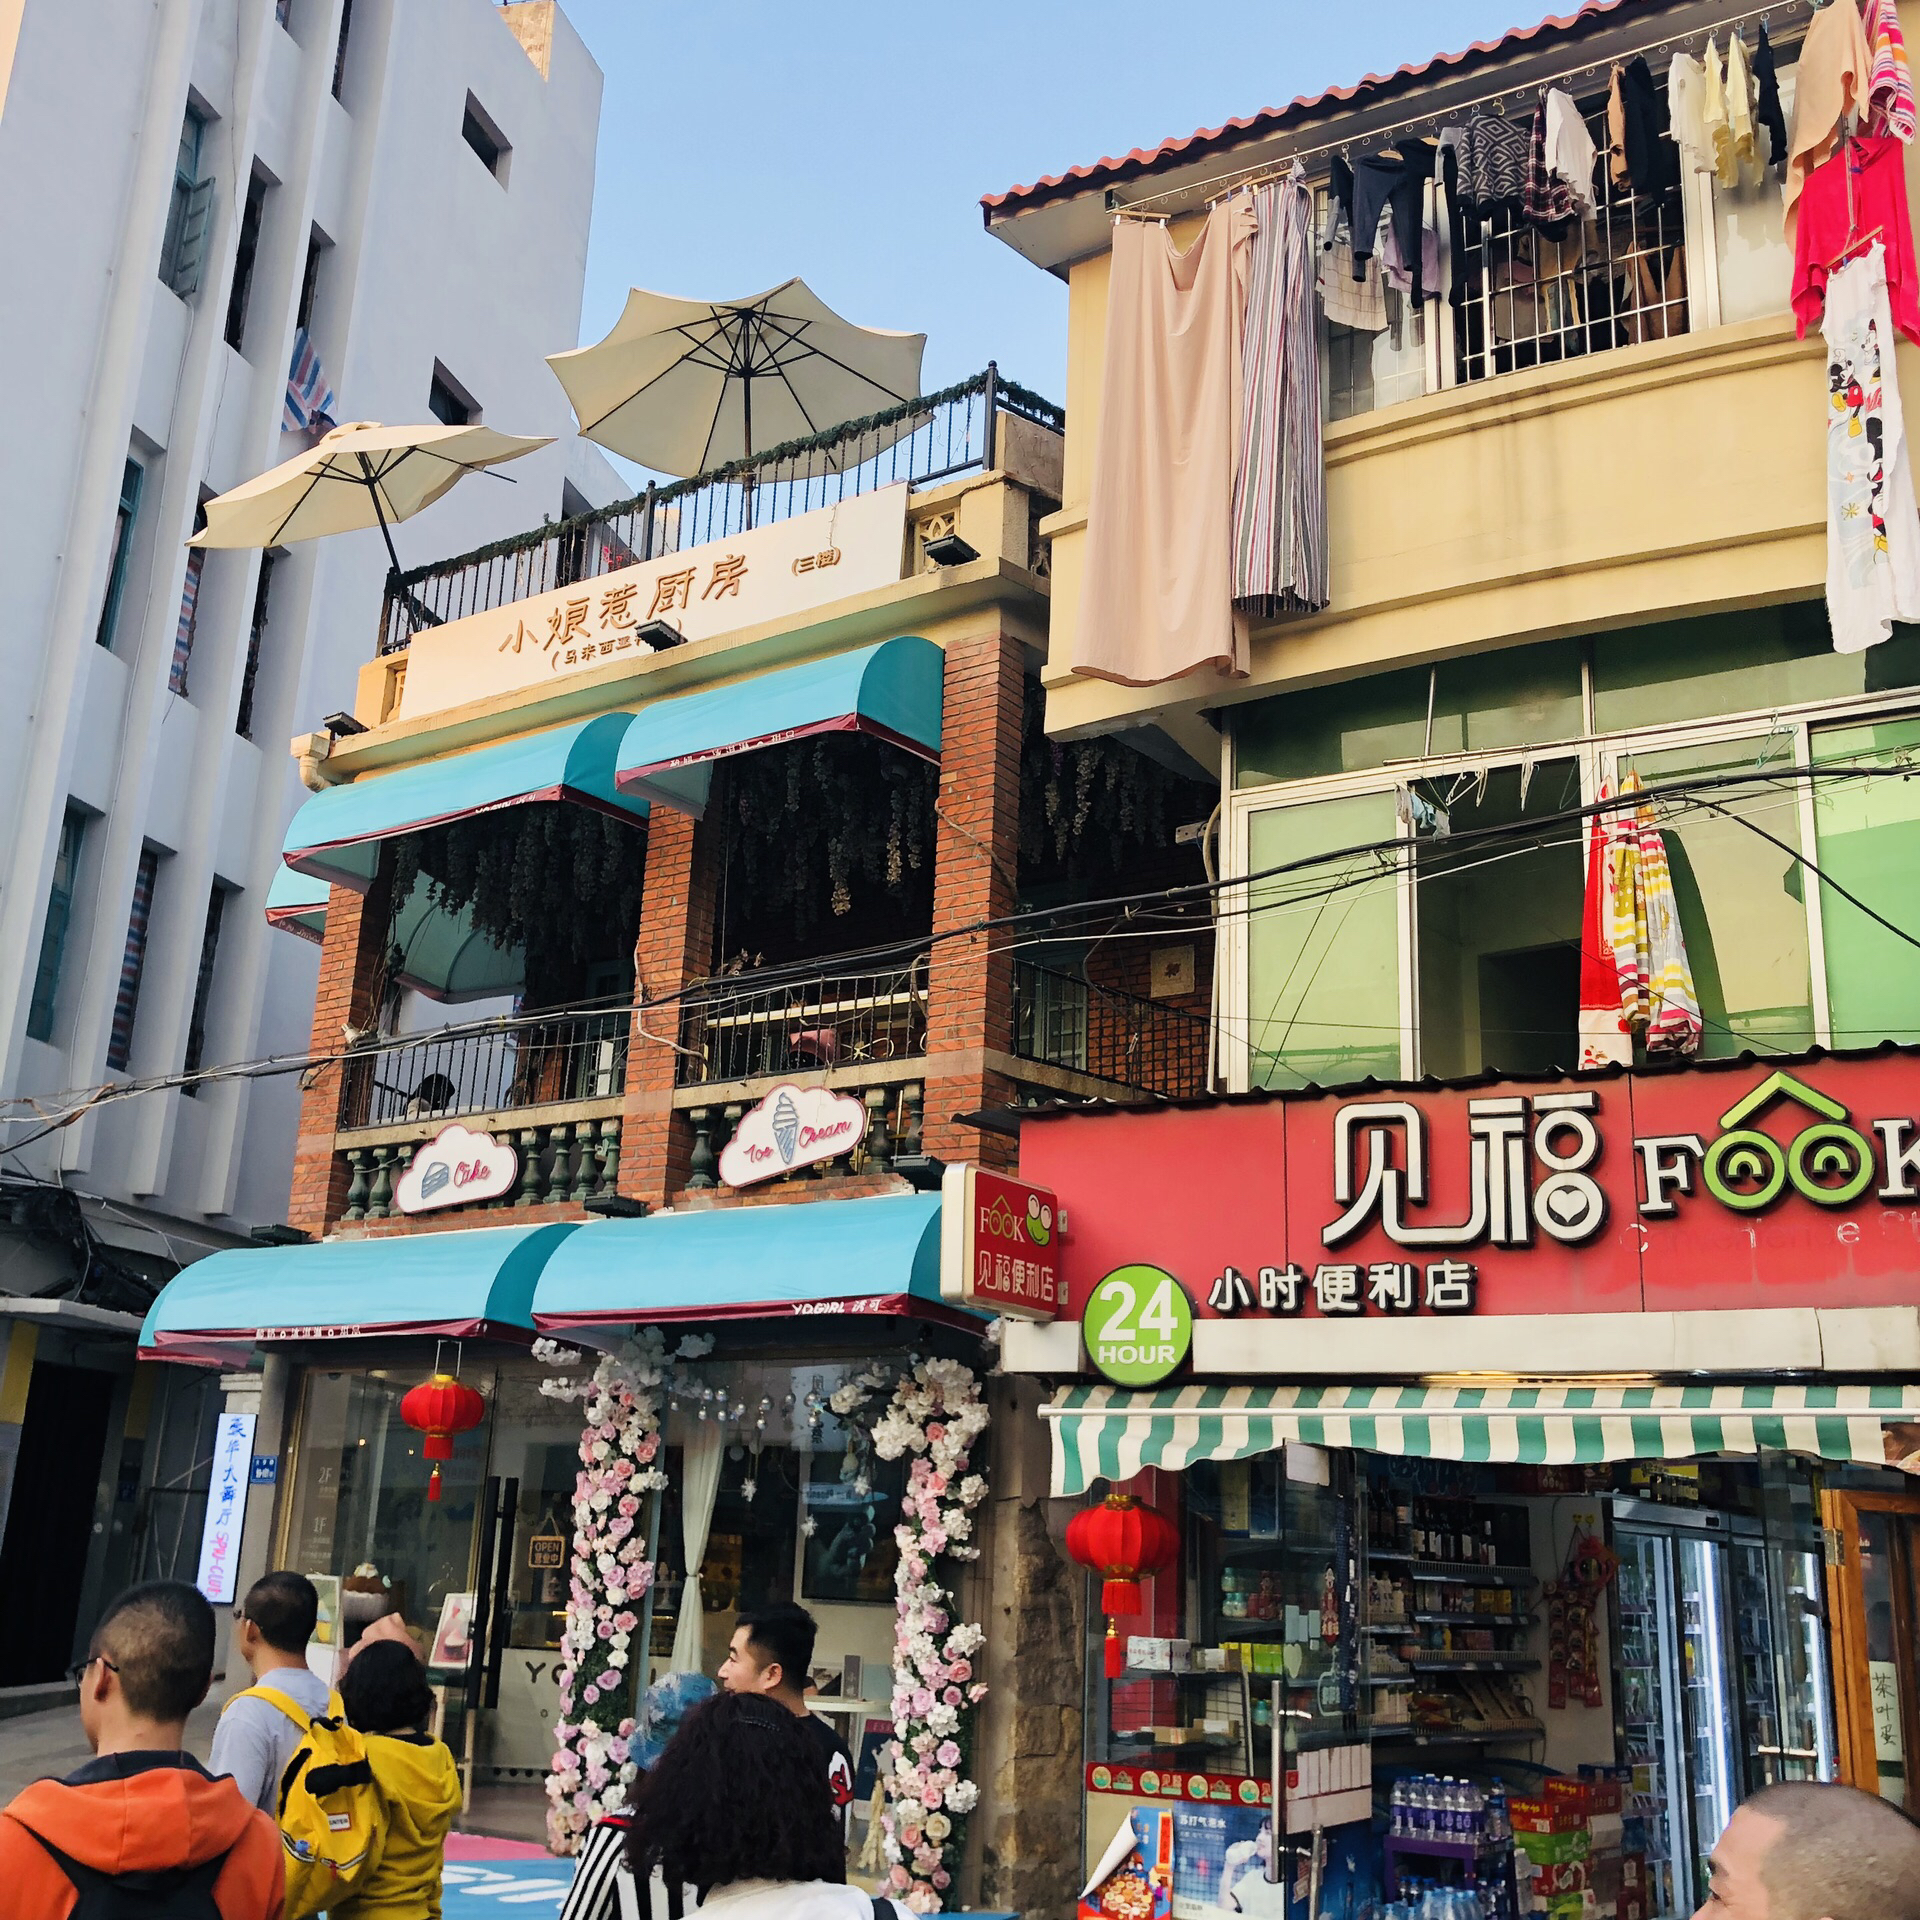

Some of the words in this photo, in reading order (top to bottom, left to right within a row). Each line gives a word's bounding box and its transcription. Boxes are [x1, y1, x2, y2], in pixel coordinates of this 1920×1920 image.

[498, 553, 748, 653] 小娘惹厨房
[799, 1121, 853, 1149] Cream
[454, 1159, 492, 1188] Cake
[1322, 1091, 1608, 1248] 见福
[979, 1206, 1025, 1243] FOOK
[977, 1250, 1054, 1302] 见福便利店
[1207, 1258, 1476, 1315] 小时便利店
[1098, 1280, 1179, 1343] 24
[1097, 1344, 1176, 1365] HOUR
[535, 1542, 560, 1552] OPEN
[1872, 1672, 1898, 1746] 茶叶蛋
